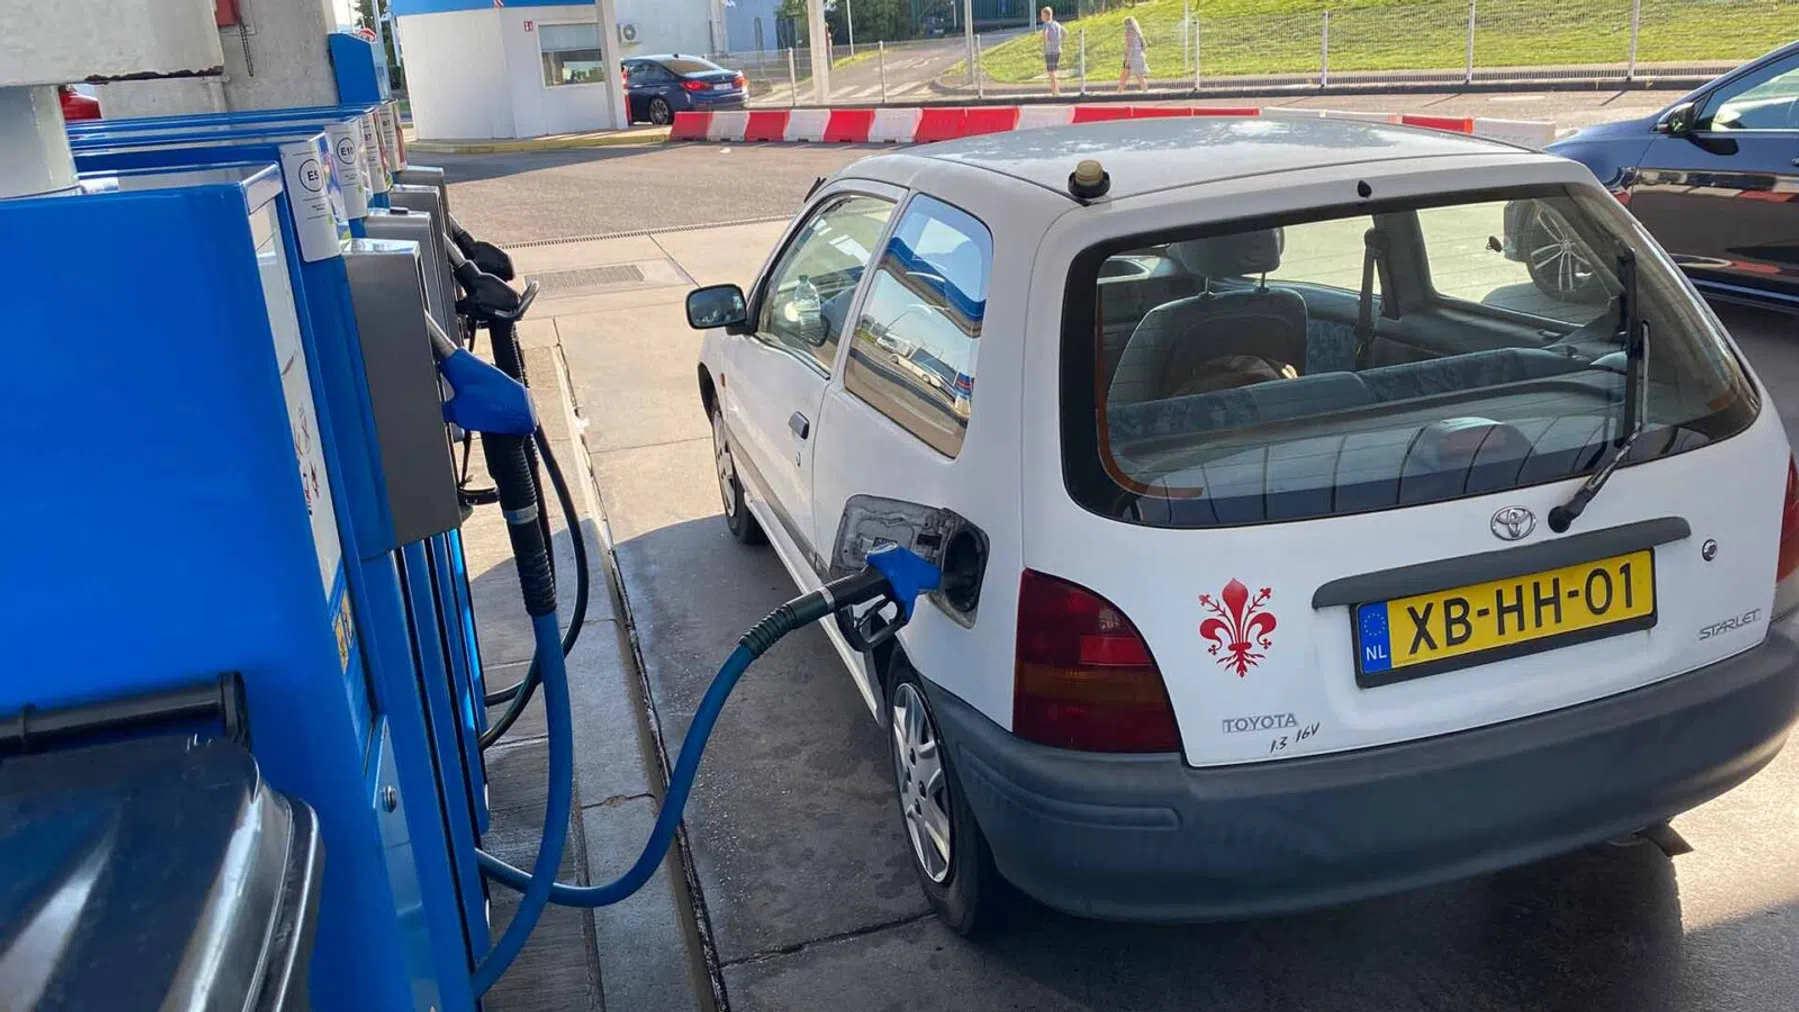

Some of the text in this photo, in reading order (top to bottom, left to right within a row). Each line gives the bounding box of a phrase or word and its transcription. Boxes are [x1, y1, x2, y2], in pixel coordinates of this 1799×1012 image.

[307, 170, 320, 181] E5
[1406, 562, 1633, 655] XB-HH-01
[1698, 607, 1762, 641] STARLET
[1366, 644, 1388, 661] NL
[1222, 713, 1298, 733] TOYOTA
[1269, 721, 1320, 754] 1.3 16V
